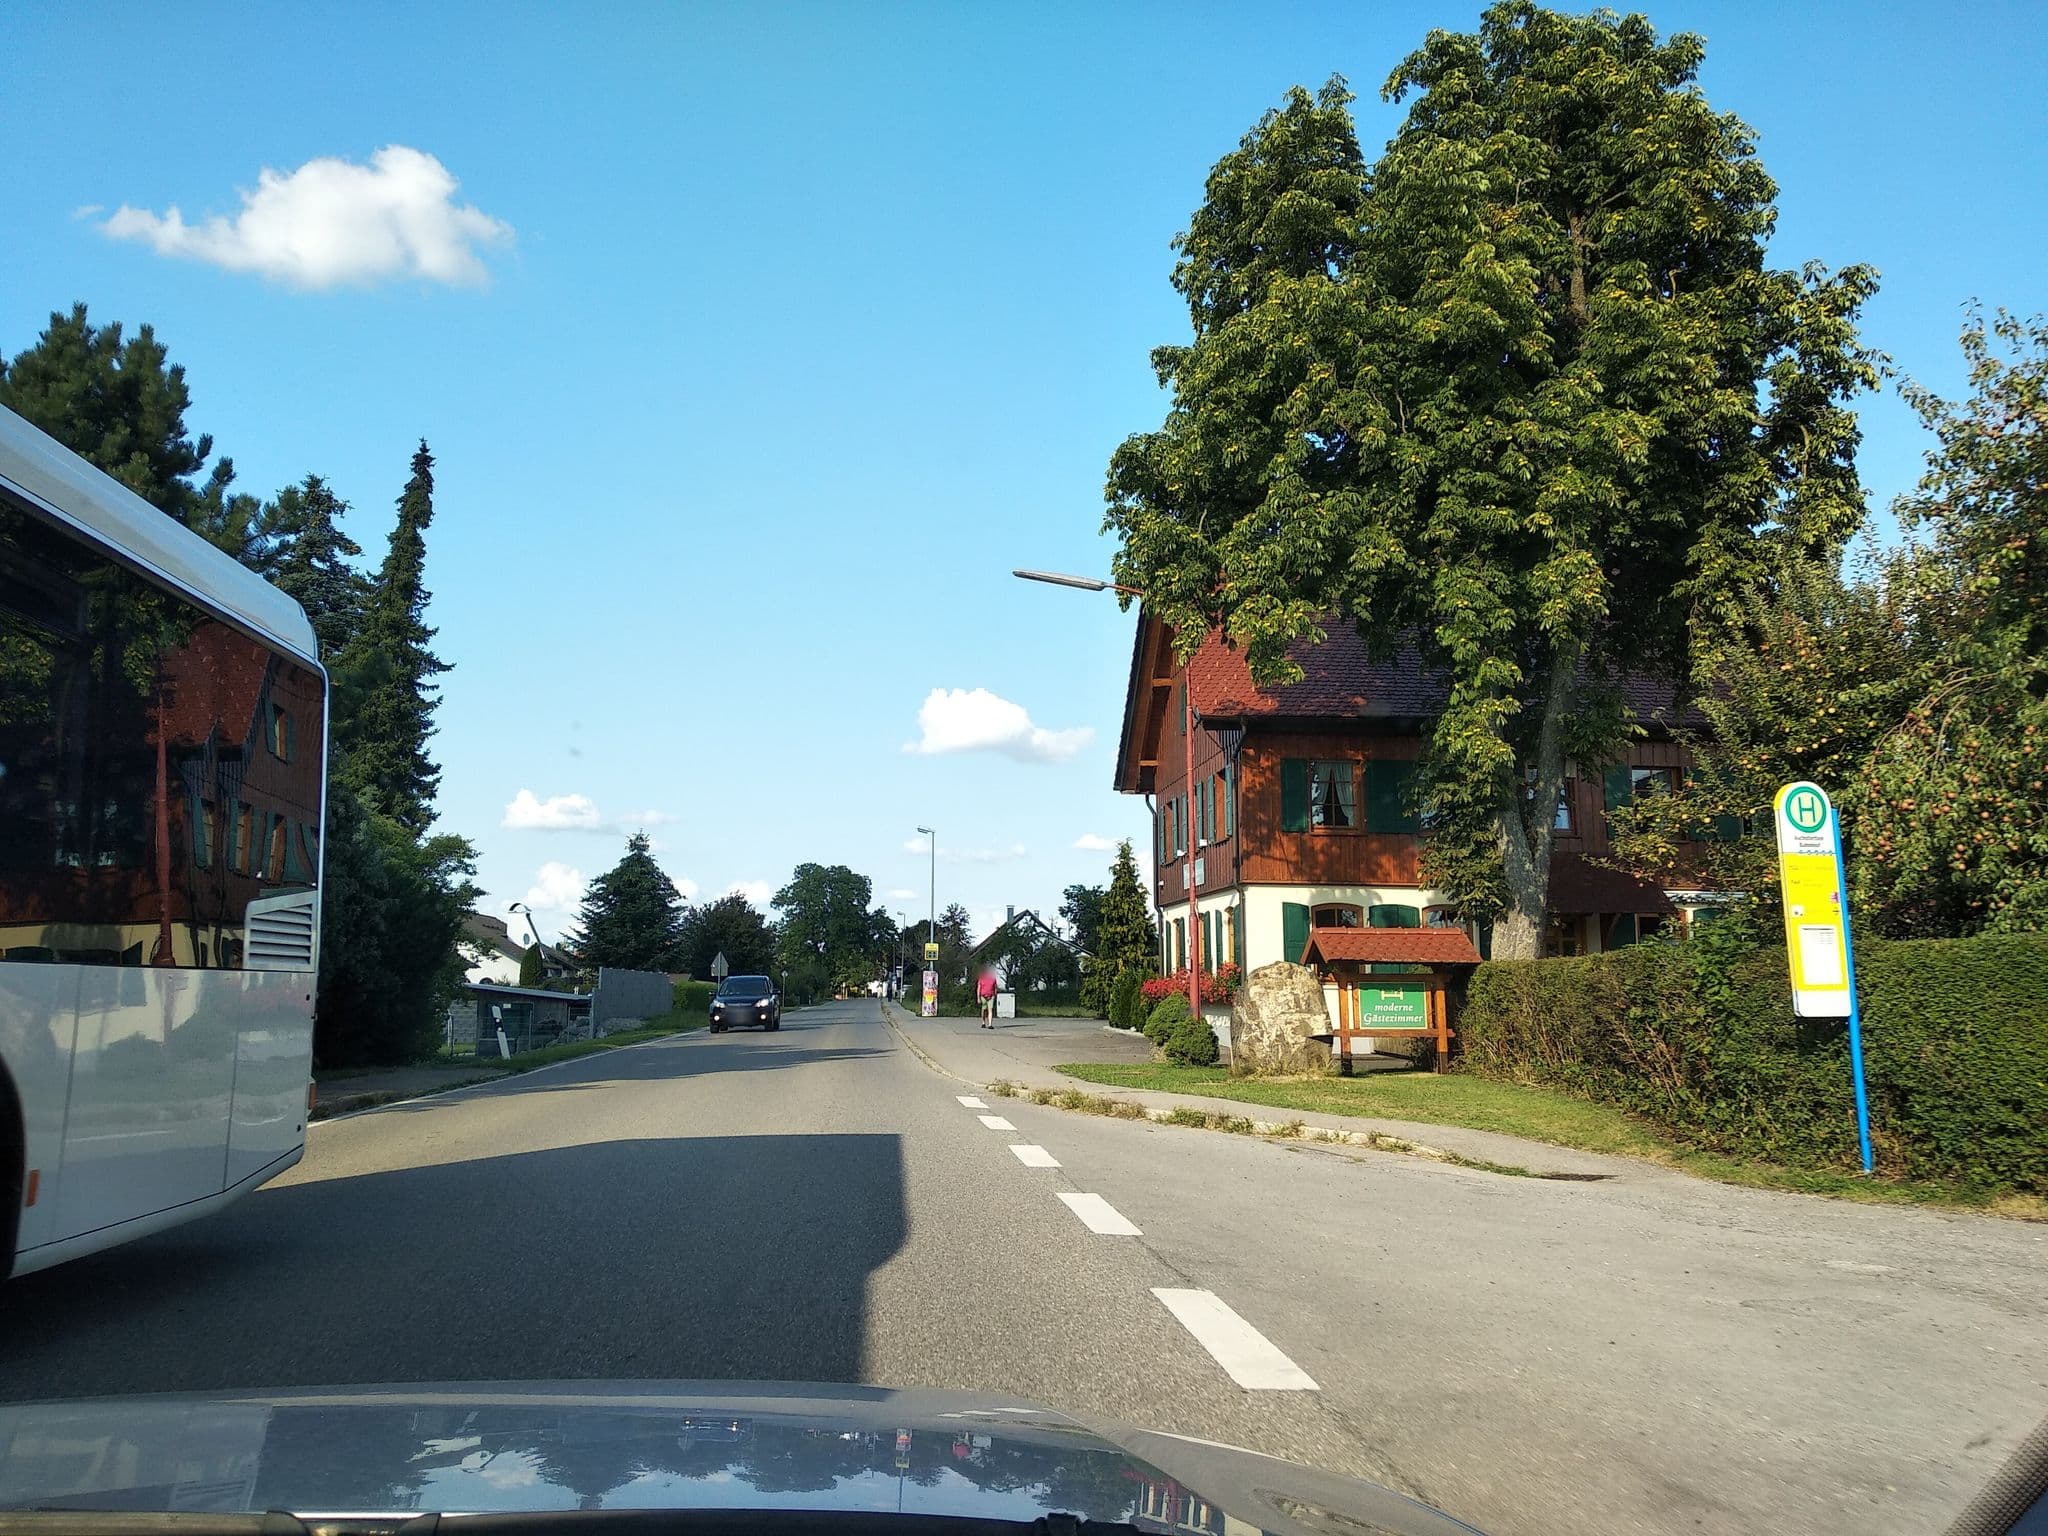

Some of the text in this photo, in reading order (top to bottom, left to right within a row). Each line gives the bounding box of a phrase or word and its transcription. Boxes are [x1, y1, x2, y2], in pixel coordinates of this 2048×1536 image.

[1798, 796, 1816, 823] H
[1374, 1002, 1414, 1012] moderne
[1363, 1013, 1424, 1025] Gästezimmer
